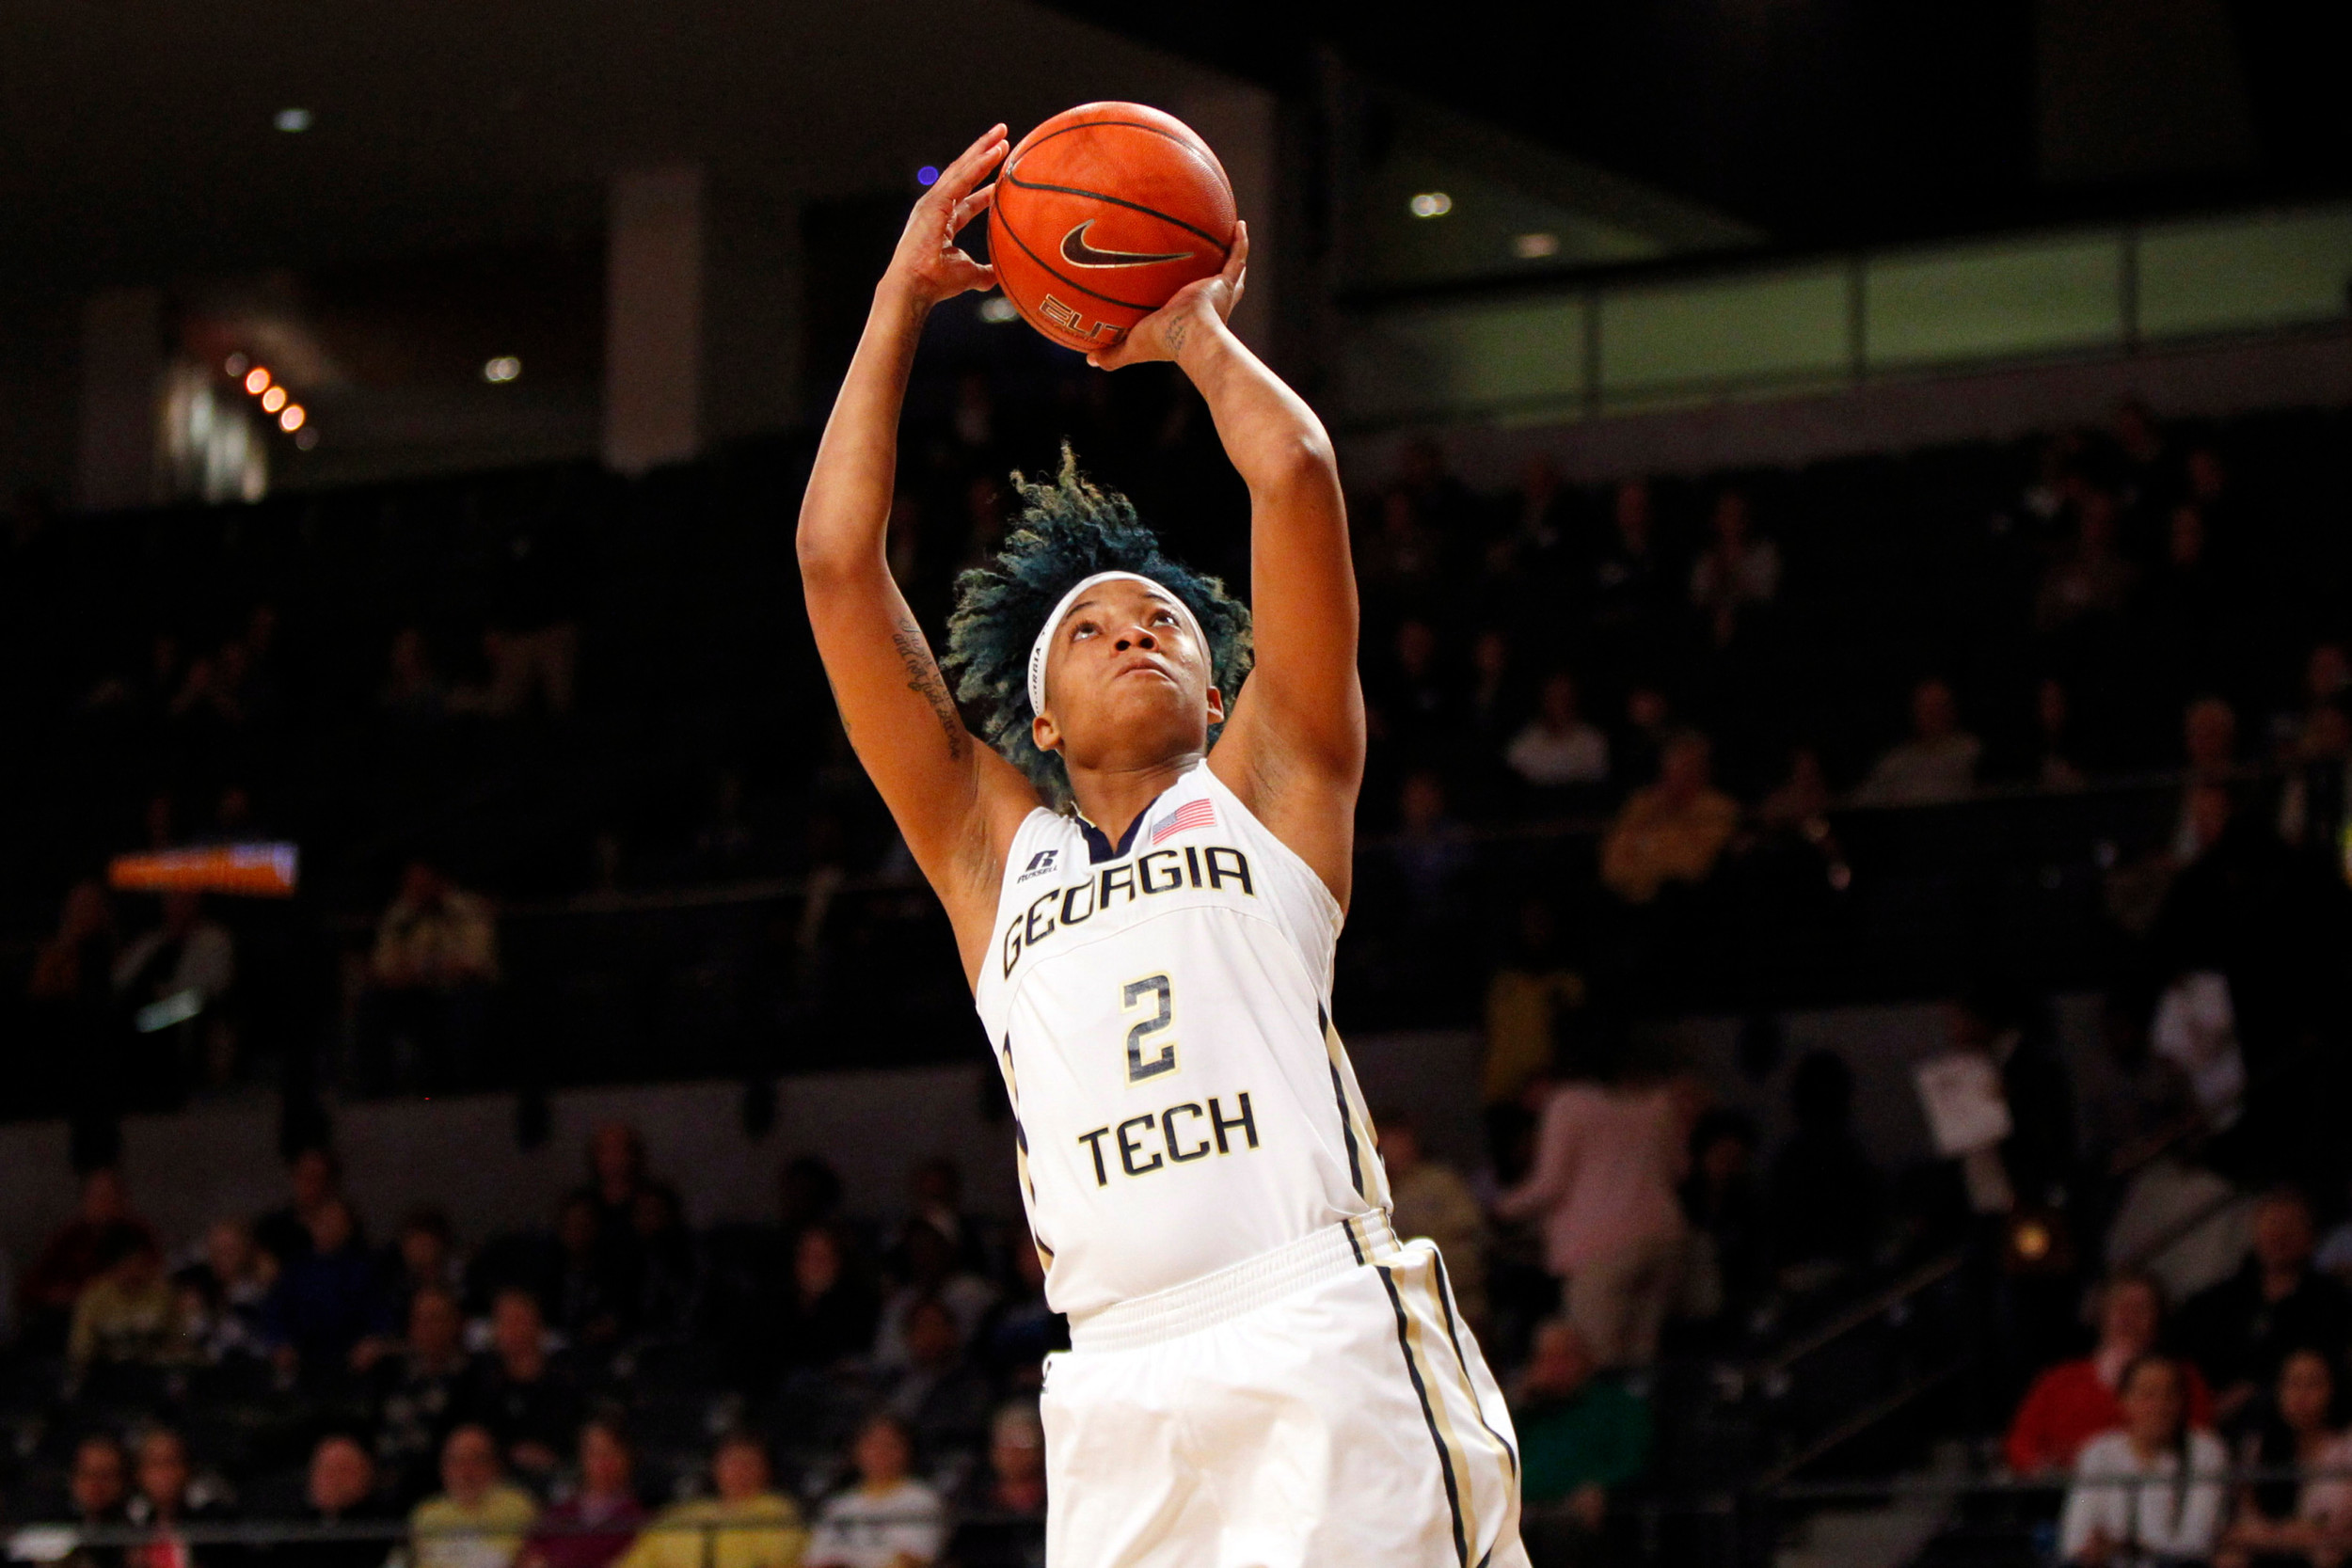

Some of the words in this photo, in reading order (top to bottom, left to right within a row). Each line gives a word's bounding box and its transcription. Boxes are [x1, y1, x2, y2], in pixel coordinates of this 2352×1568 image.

[1039, 293, 1129, 344] ELIT
[1002, 845, 1258, 981] GEORGIA
[1016, 864, 1058, 884] RUSSELL
[1120, 970, 1181, 1089] 2
[1077, 1090, 1262, 1190] TECH
